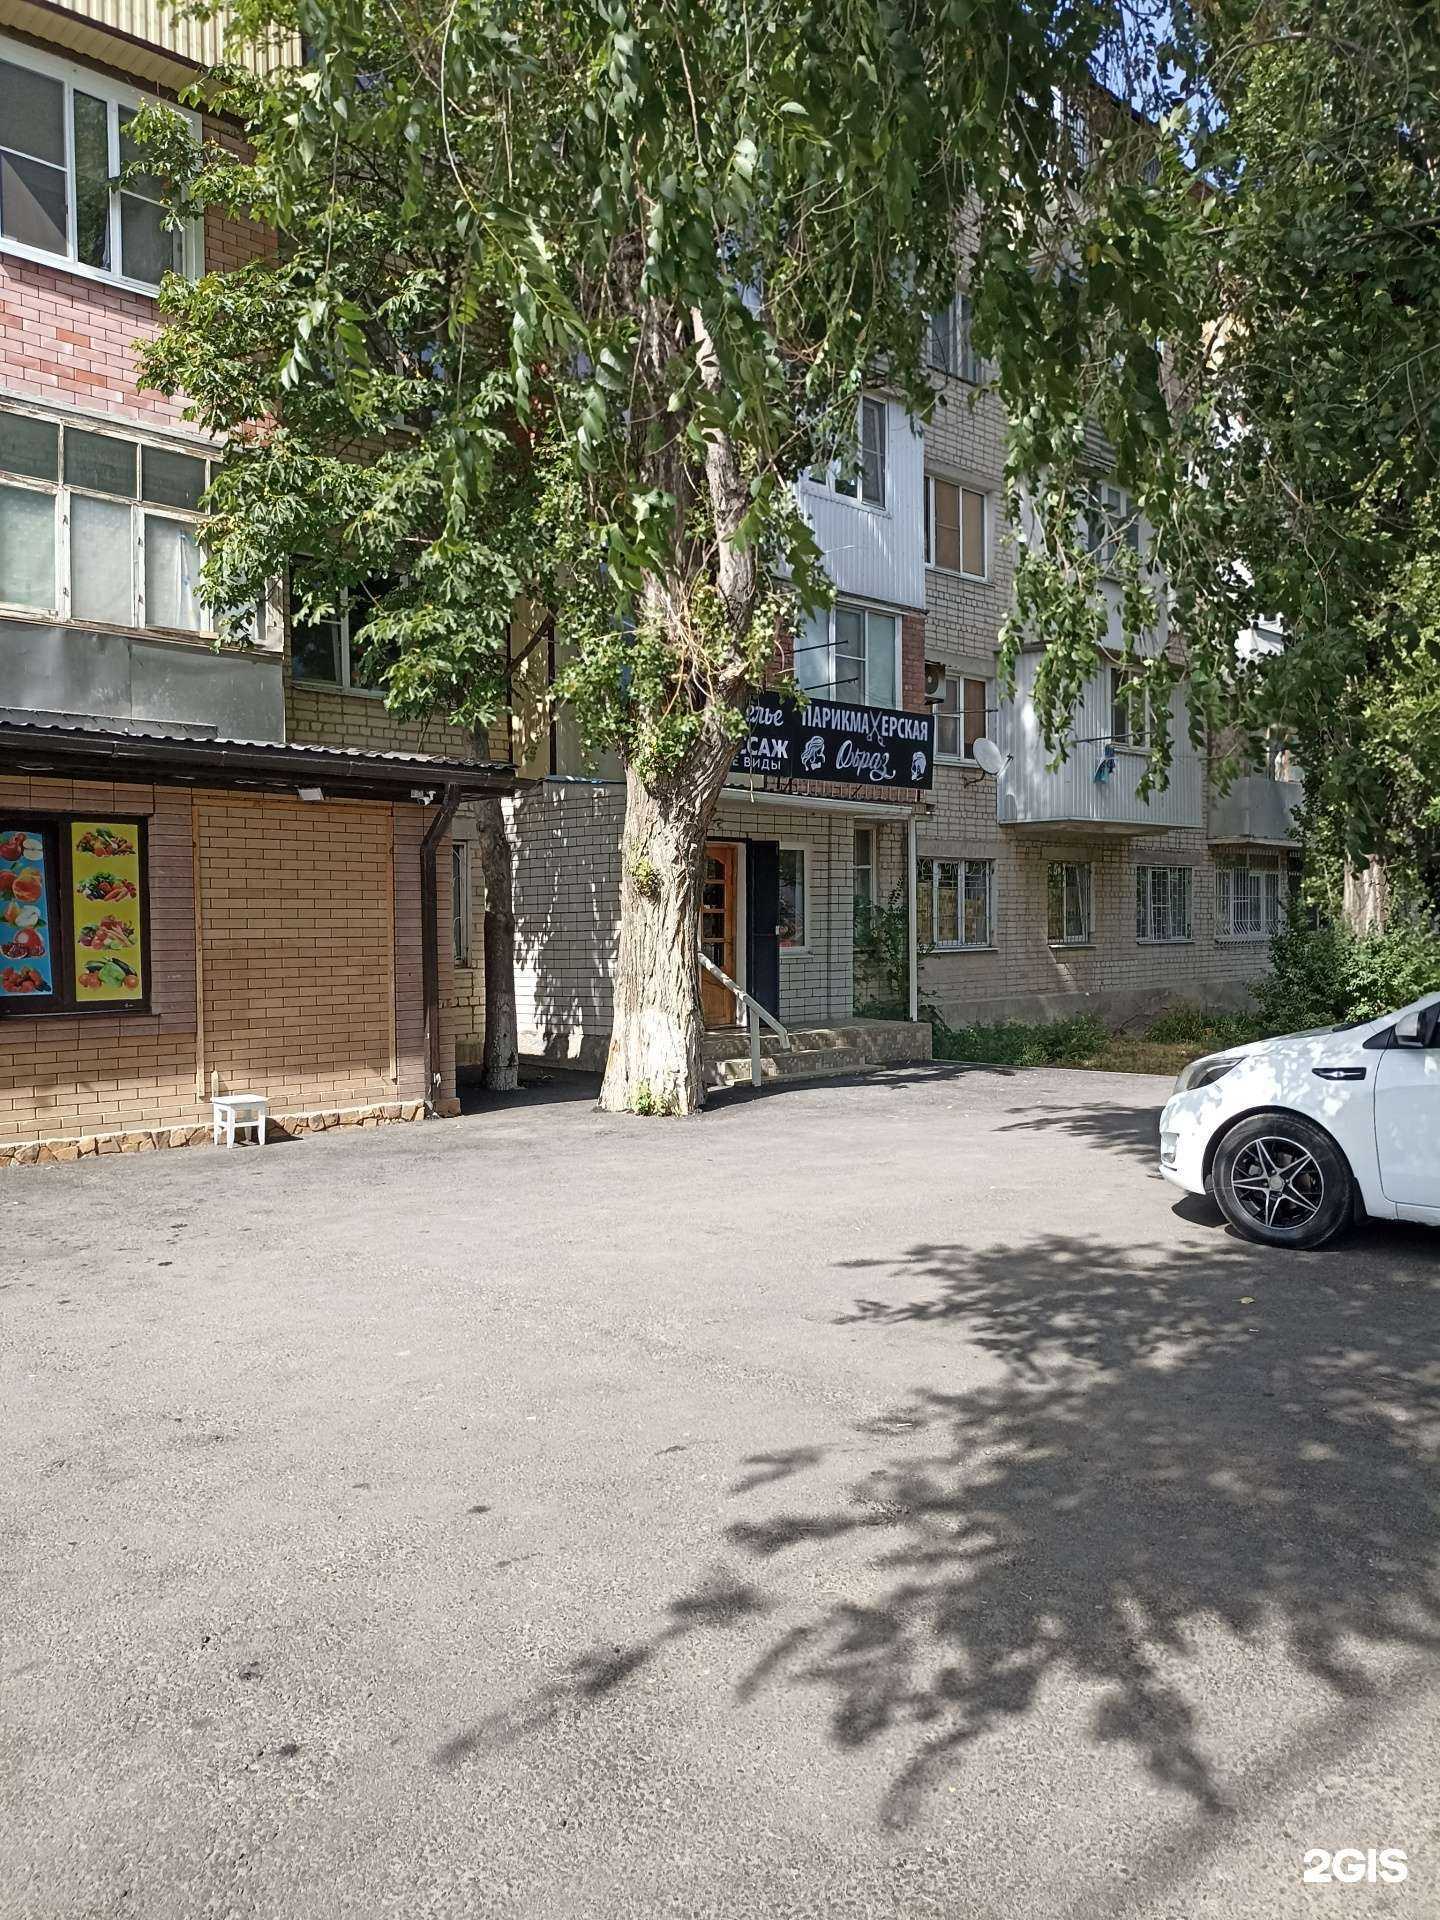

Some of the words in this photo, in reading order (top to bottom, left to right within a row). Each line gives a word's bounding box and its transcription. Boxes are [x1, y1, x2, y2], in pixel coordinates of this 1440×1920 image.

[745, 705, 784, 726] елье
[802, 705, 928, 746] ПАРИКМАХЕРСКАЯ
[740, 736, 789, 759] САЖ
[743, 756, 781, 771] ВИДЫ
[836, 740, 896, 781] Образ
